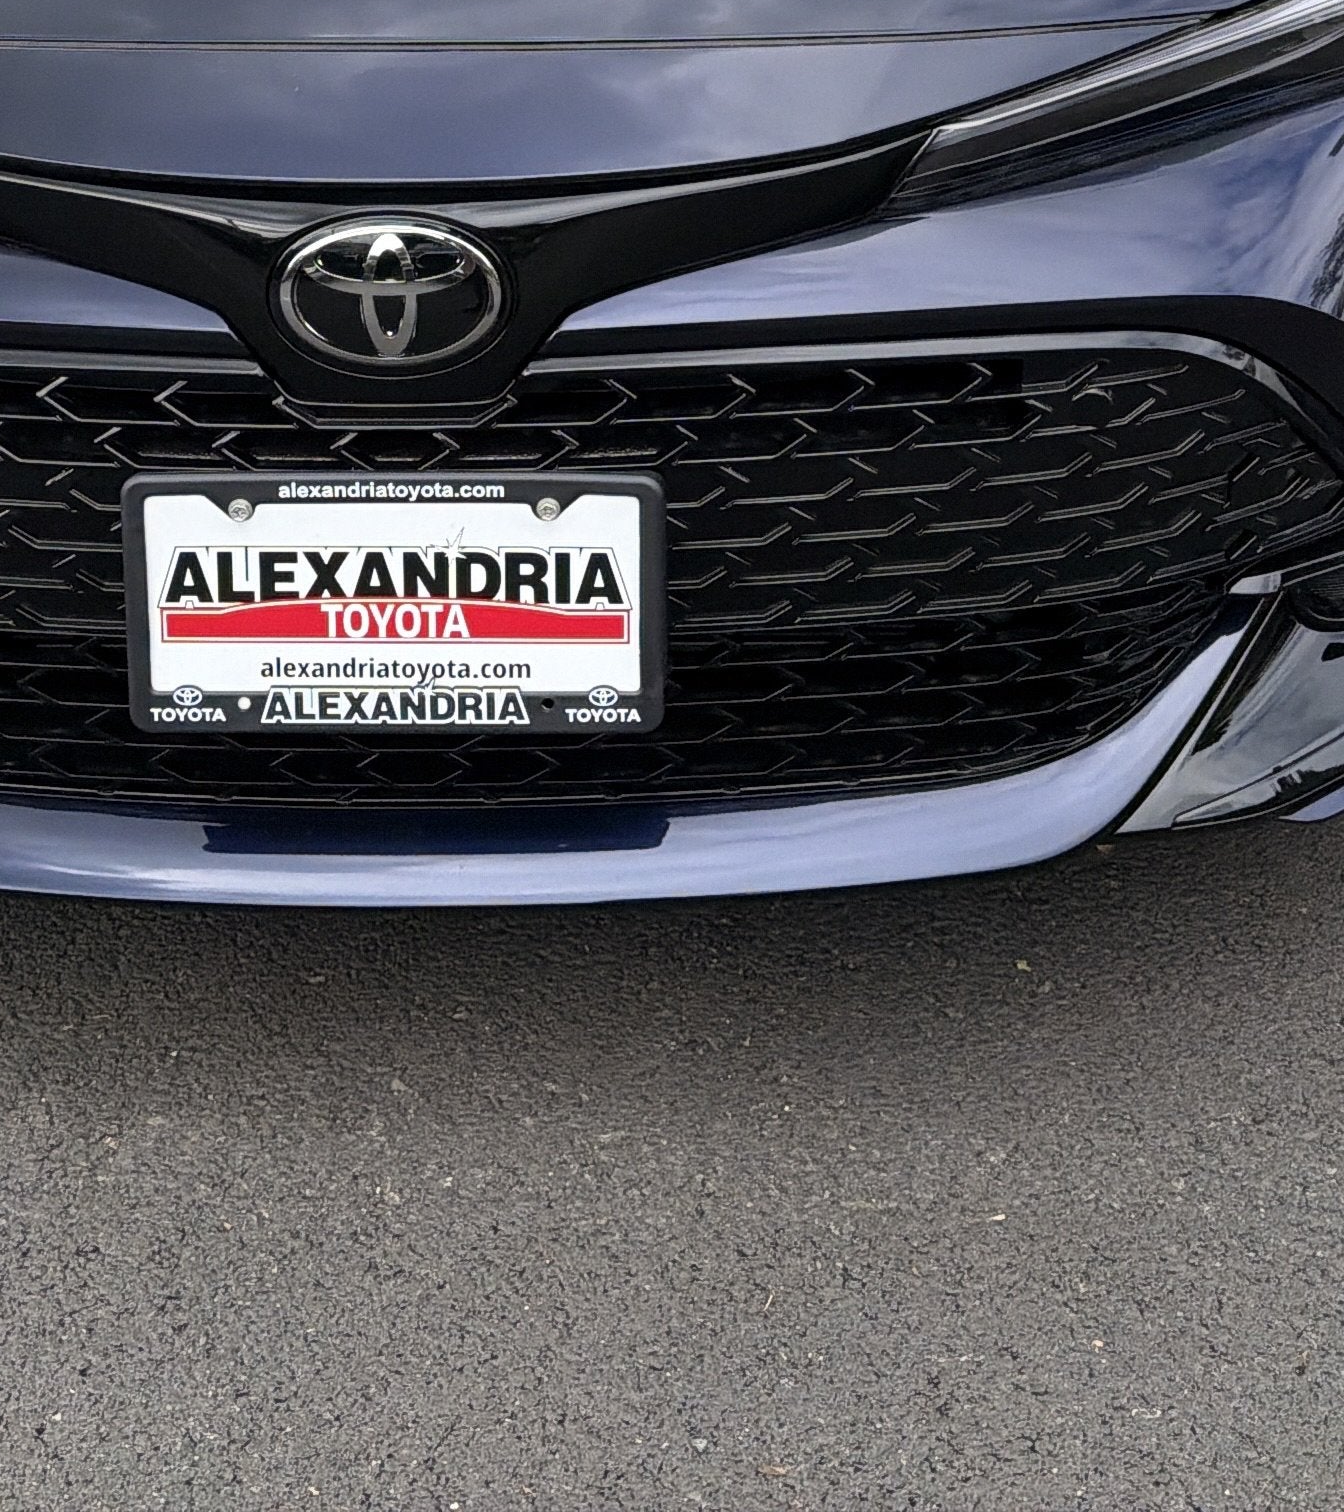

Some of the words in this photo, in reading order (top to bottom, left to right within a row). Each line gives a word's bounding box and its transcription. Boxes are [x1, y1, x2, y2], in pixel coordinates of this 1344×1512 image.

[277, 479, 505, 501] alexandriatoyota.com
[162, 548, 626, 607] ALEXANDRIA
[321, 603, 471, 639] TOYOTA
[260, 657, 532, 685] alexandriatoyota.com
[150, 707, 227, 724] TOYOTA
[262, 686, 531, 725] ALEXANDRIA
[566, 707, 642, 724] TOYOTA
